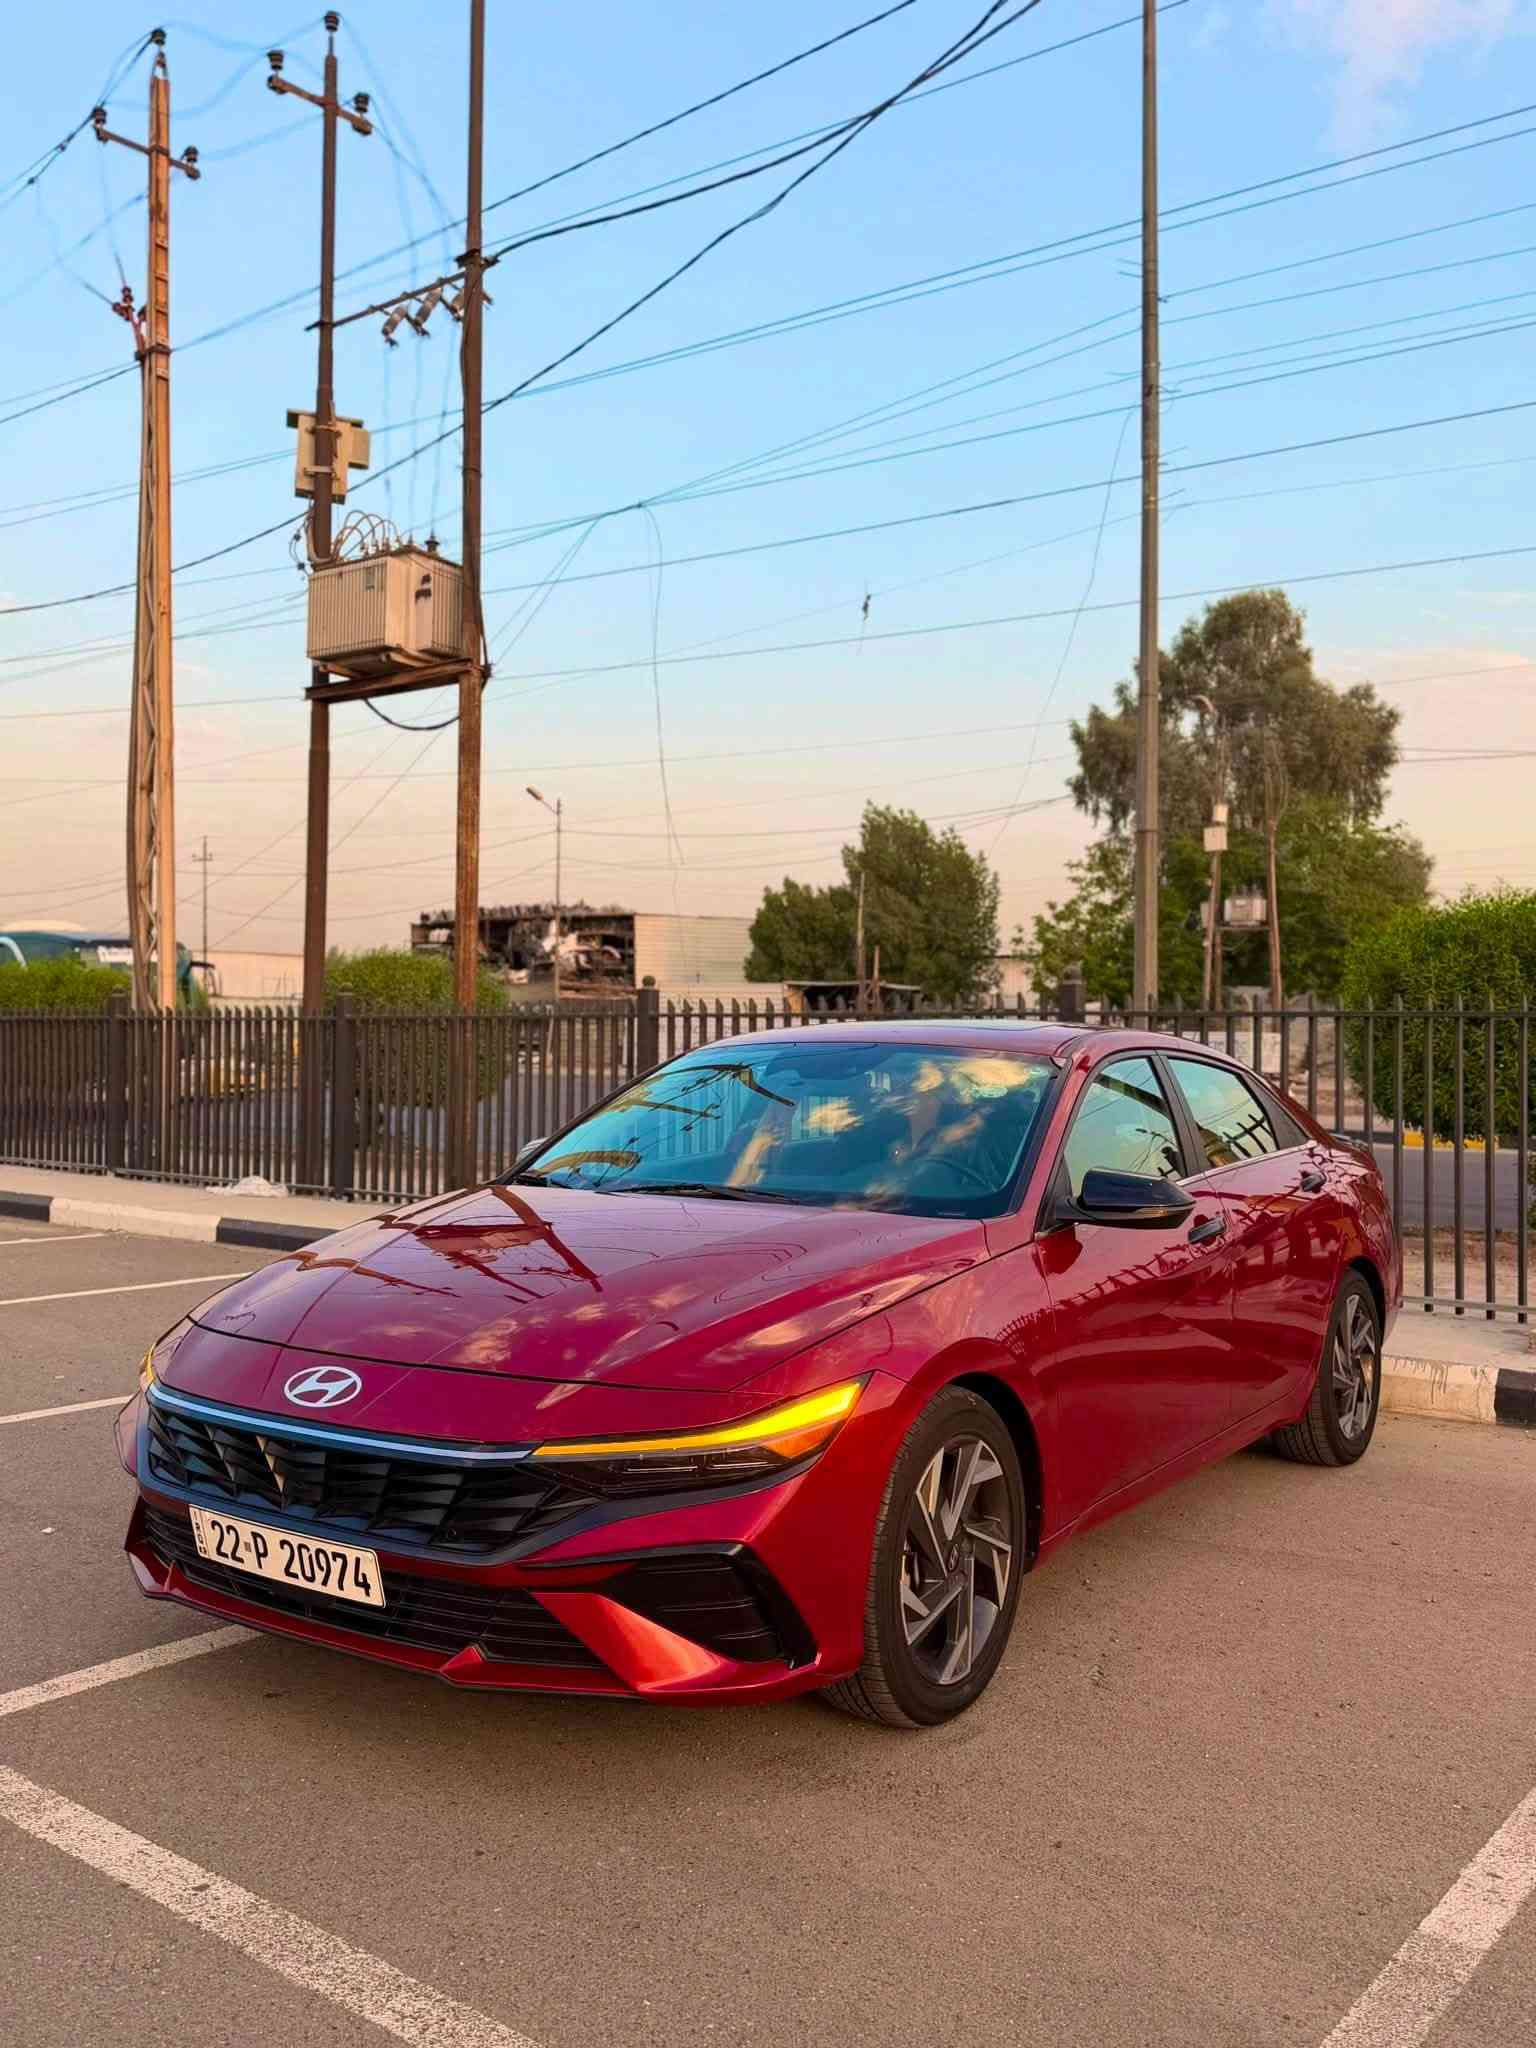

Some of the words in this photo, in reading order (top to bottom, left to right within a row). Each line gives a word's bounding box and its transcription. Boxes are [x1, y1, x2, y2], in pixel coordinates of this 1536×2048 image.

[211, 1519, 244, 1563] 22
[251, 1531, 268, 1569] P
[279, 1539, 371, 1597] 20974
